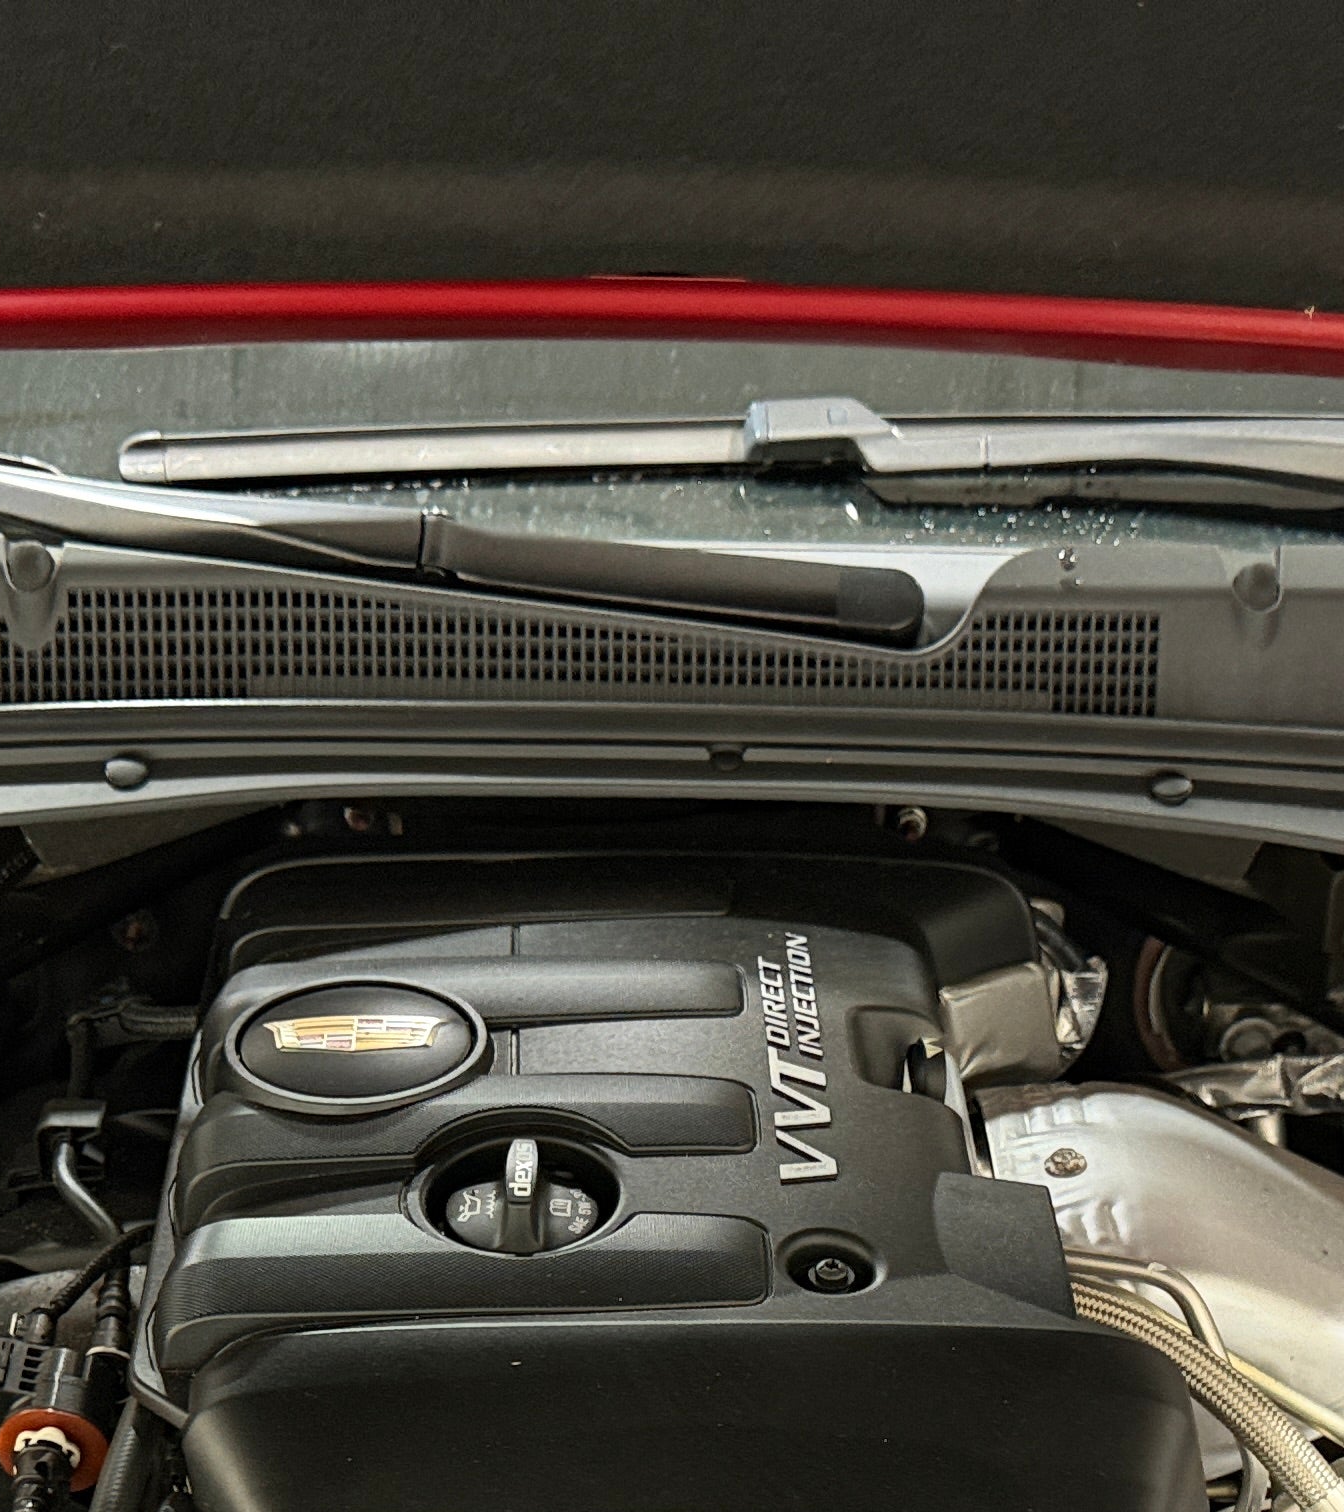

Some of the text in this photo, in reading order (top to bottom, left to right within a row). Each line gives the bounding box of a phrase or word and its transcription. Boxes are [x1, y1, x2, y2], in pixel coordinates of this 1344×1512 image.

[758, 955, 790, 1047] DIRECT
[785, 931, 824, 1057] INJECTION
[767, 1046, 839, 1184] VVT
[508, 1142, 533, 1197] dexos
[567, 1215, 590, 1235] SAE
